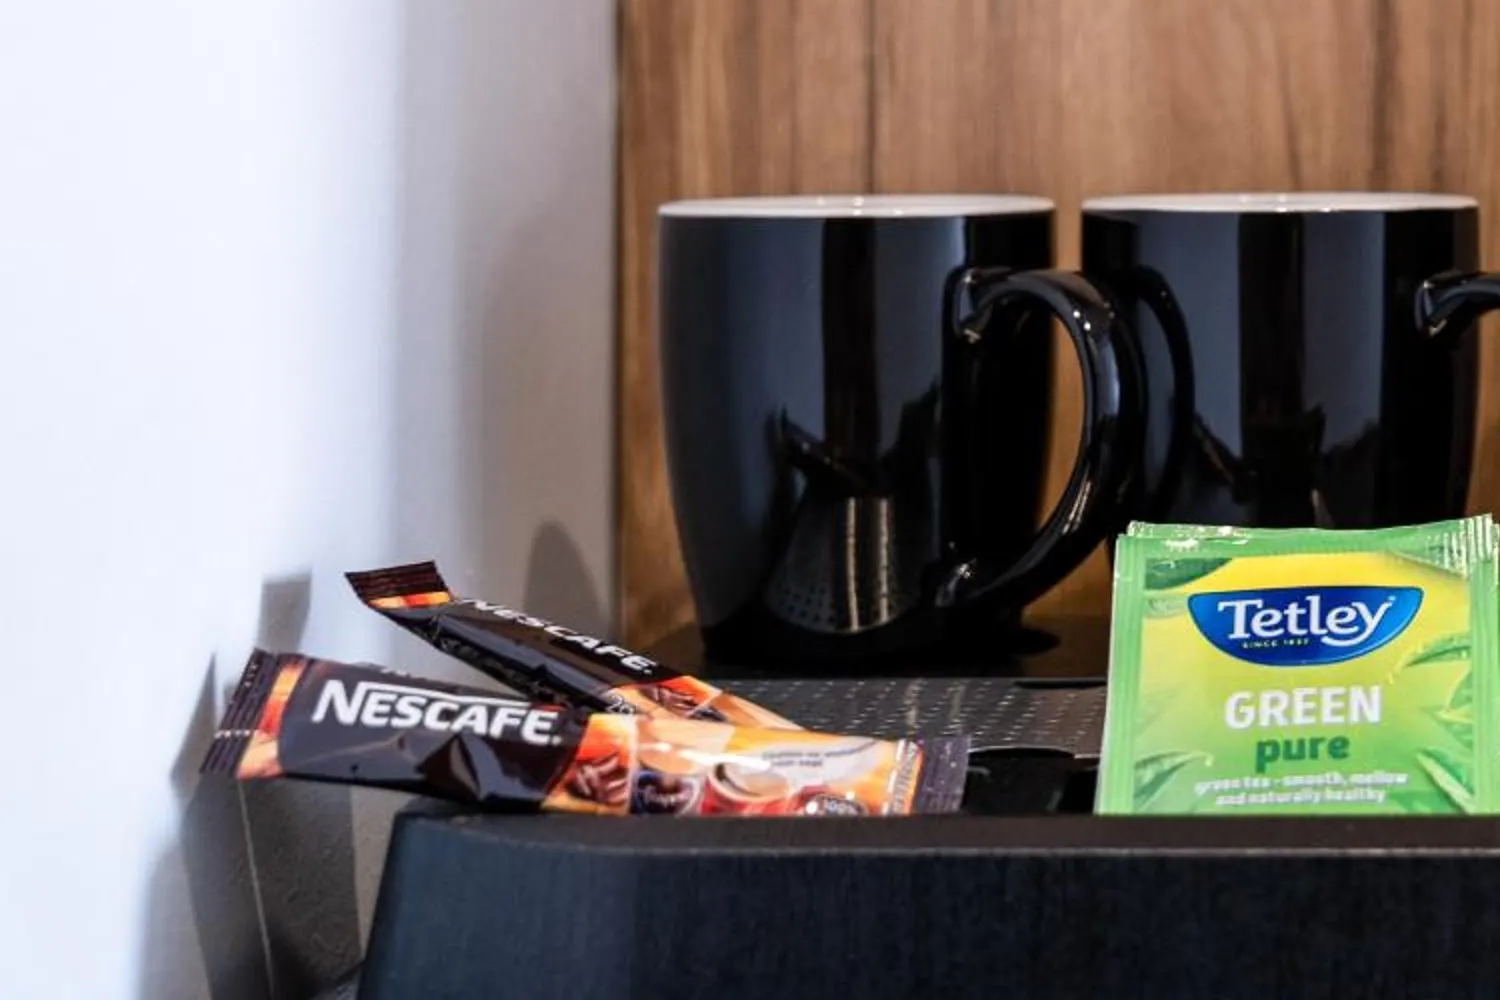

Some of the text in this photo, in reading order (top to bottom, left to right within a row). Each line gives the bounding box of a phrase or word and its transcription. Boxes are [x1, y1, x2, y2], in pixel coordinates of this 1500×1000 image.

[1217, 594, 1397, 648] Tetley
[1224, 684, 1382, 729] GREEN
[1254, 735, 1350, 774] pure
[1194, 778, 1242, 796] green
[1244, 776, 1271, 789] tea
[1350, 769, 1408, 786] mellow
[1215, 786, 1386, 806] and naturally healthy
